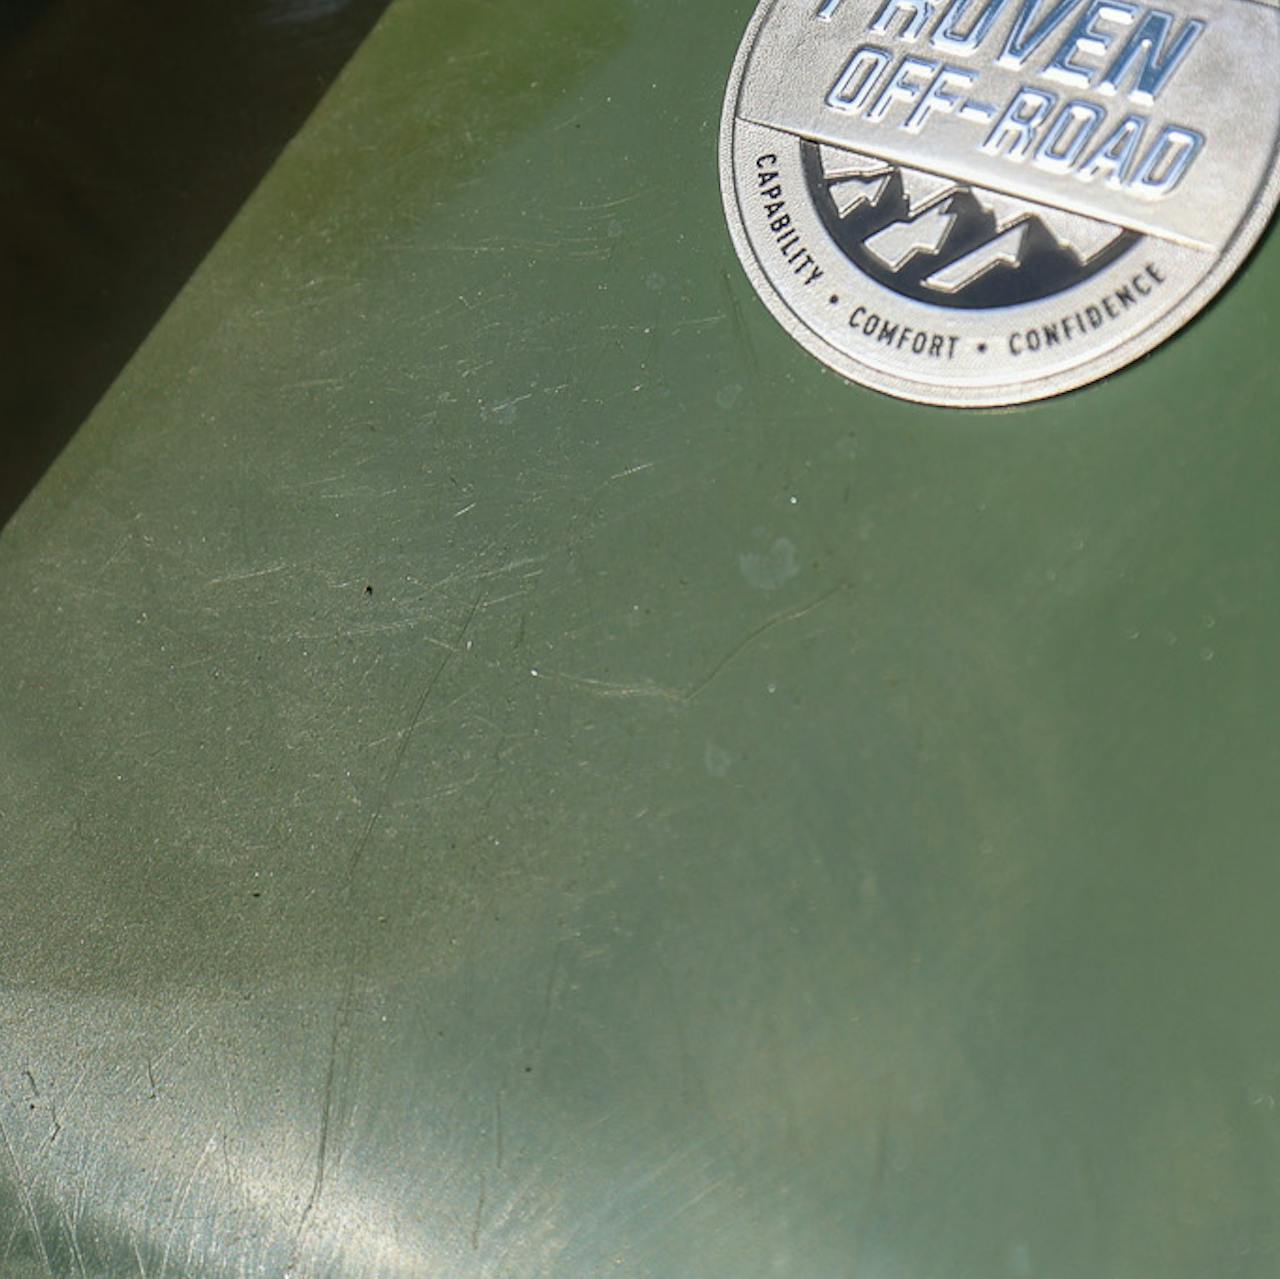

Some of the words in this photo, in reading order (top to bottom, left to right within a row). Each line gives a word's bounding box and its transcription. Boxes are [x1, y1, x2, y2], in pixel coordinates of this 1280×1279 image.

[824, 42, 1206, 199] OFF-ROAD
[756, 153, 824, 286] CAPABILITY
[848, 305, 961, 360] COMFORT
[1008, 261, 1168, 357] CONFIDENCE
